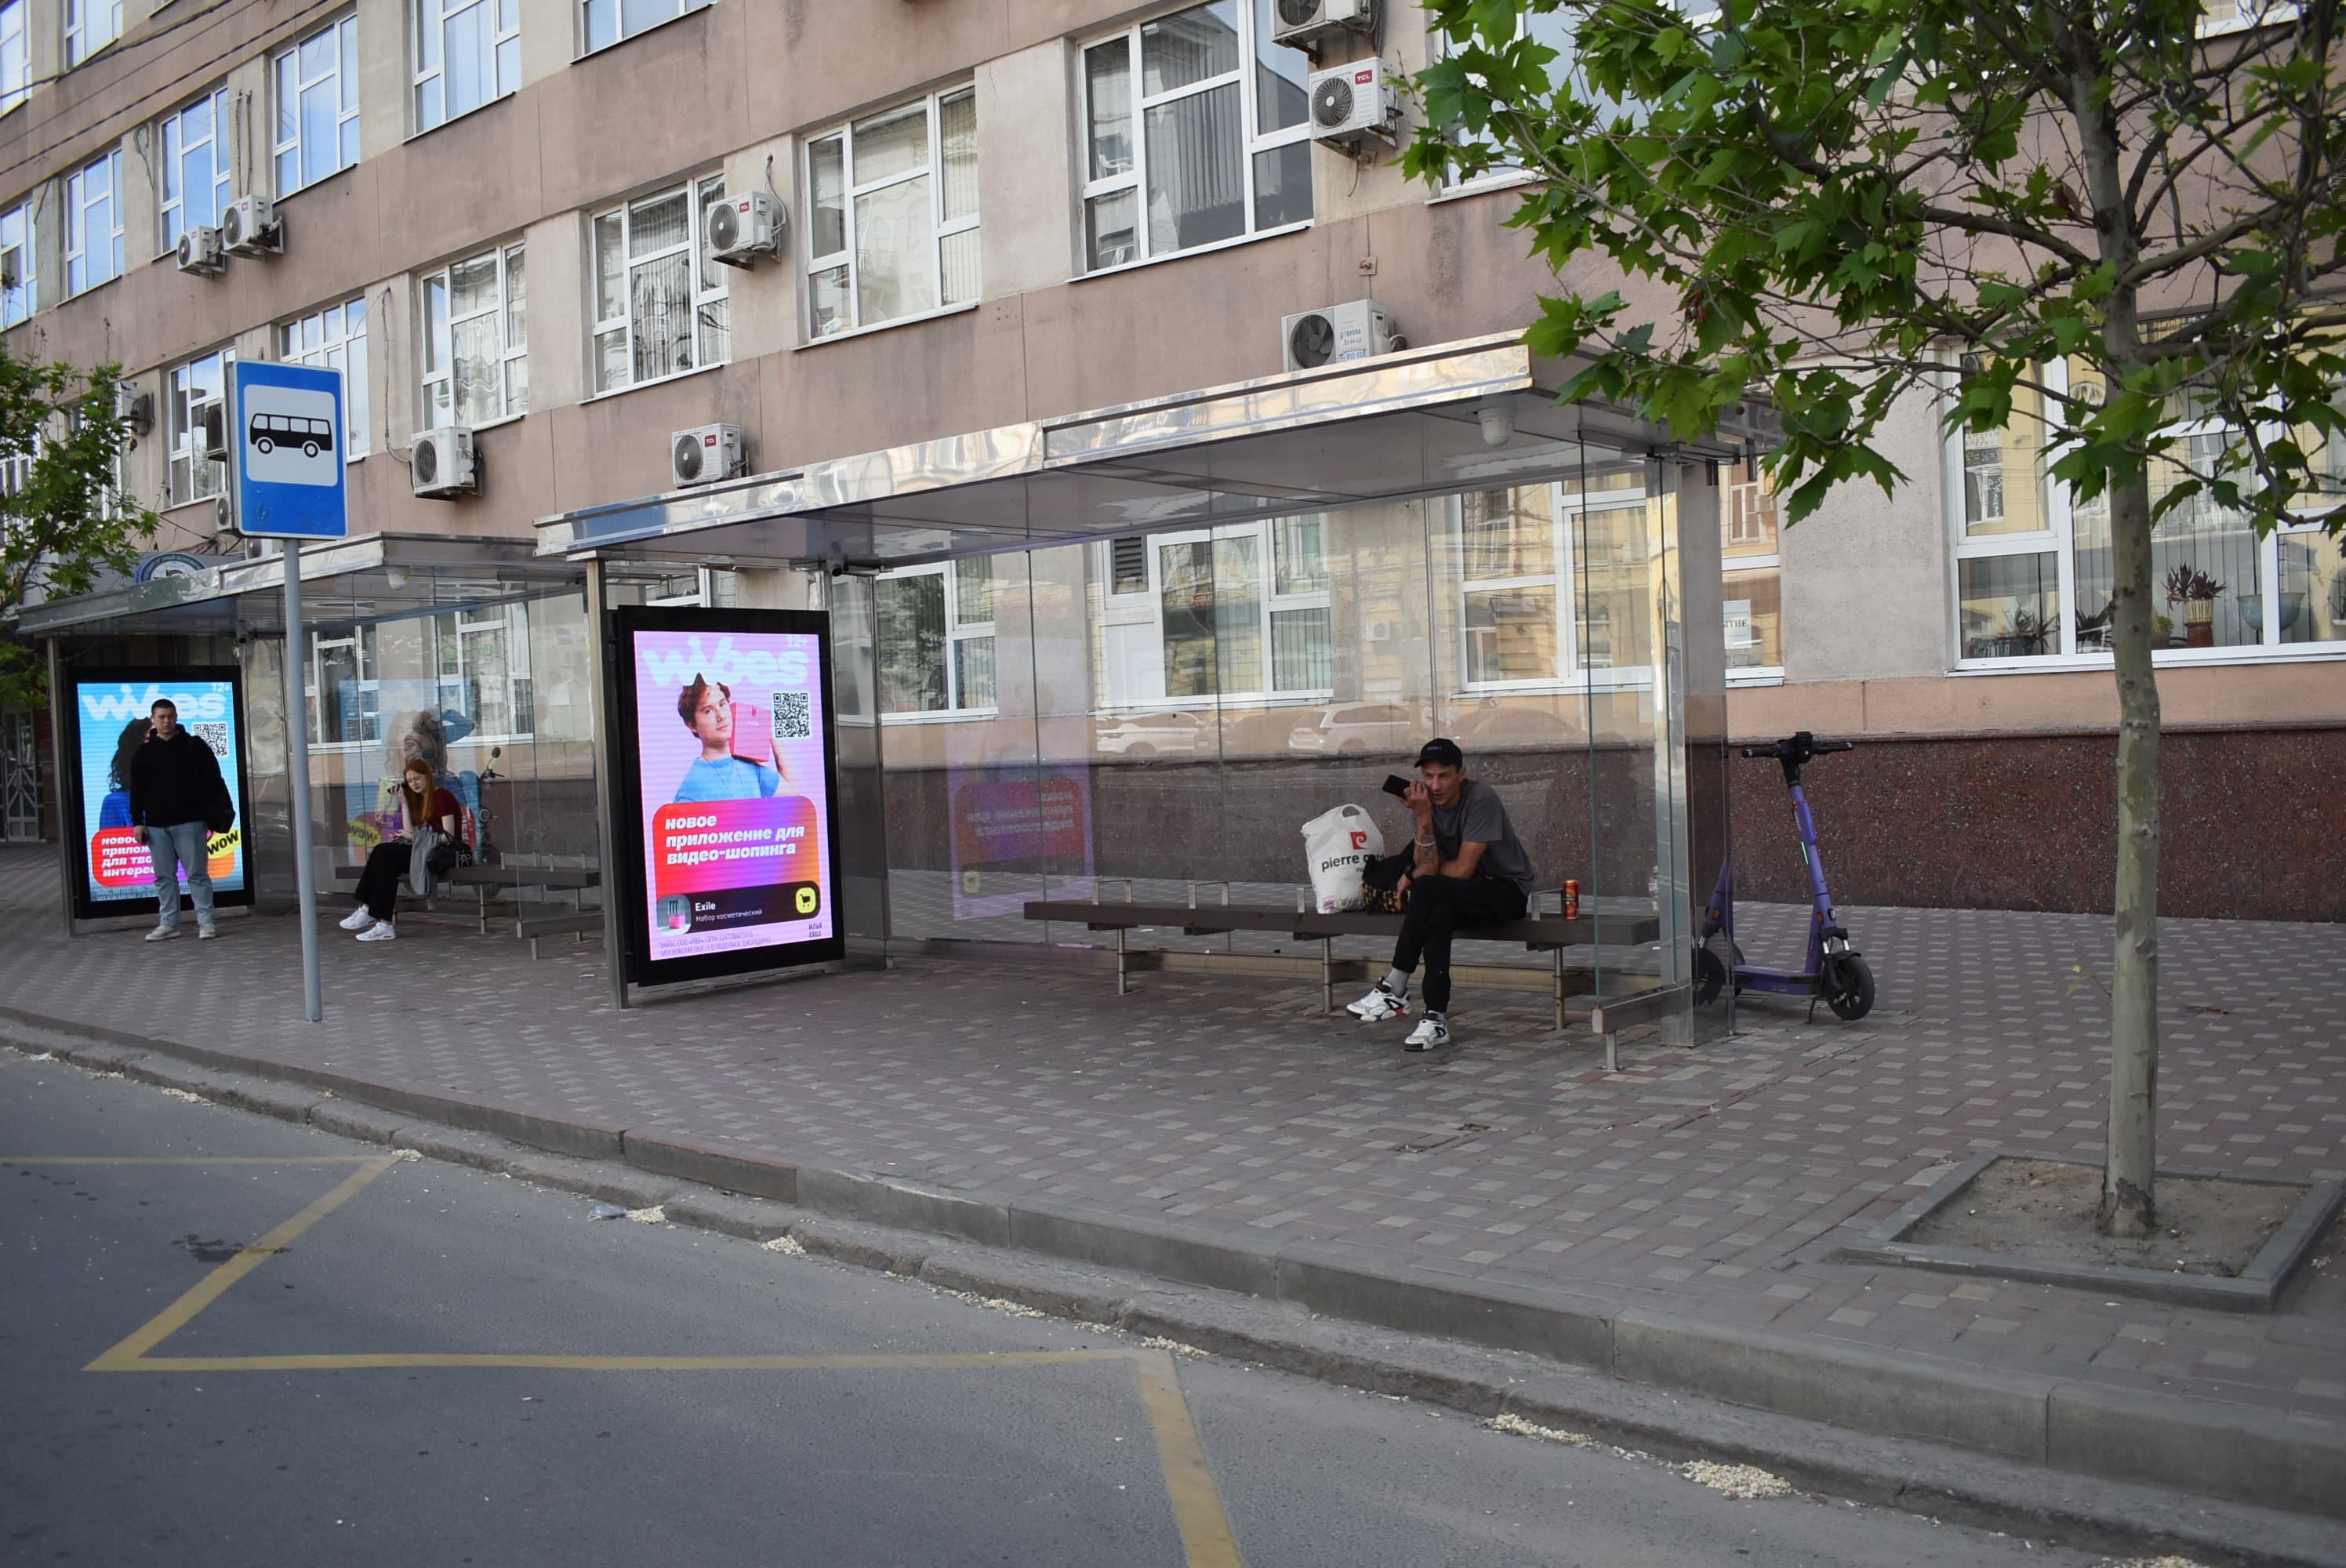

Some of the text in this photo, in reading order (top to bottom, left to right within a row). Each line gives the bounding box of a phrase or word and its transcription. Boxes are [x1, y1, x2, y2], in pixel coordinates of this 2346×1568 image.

[787, 635, 808, 647] 12+
[212, 683, 231, 692] 12+
[665, 815, 717, 829] новое
[666, 826, 805, 851] приложение для
[666, 843, 796, 866] видео-шопинга
[101, 858, 127, 868] для
[1321, 855, 1360, 872] pierre
[695, 902, 716, 912] Exile
[717, 909, 763, 920] косметический
